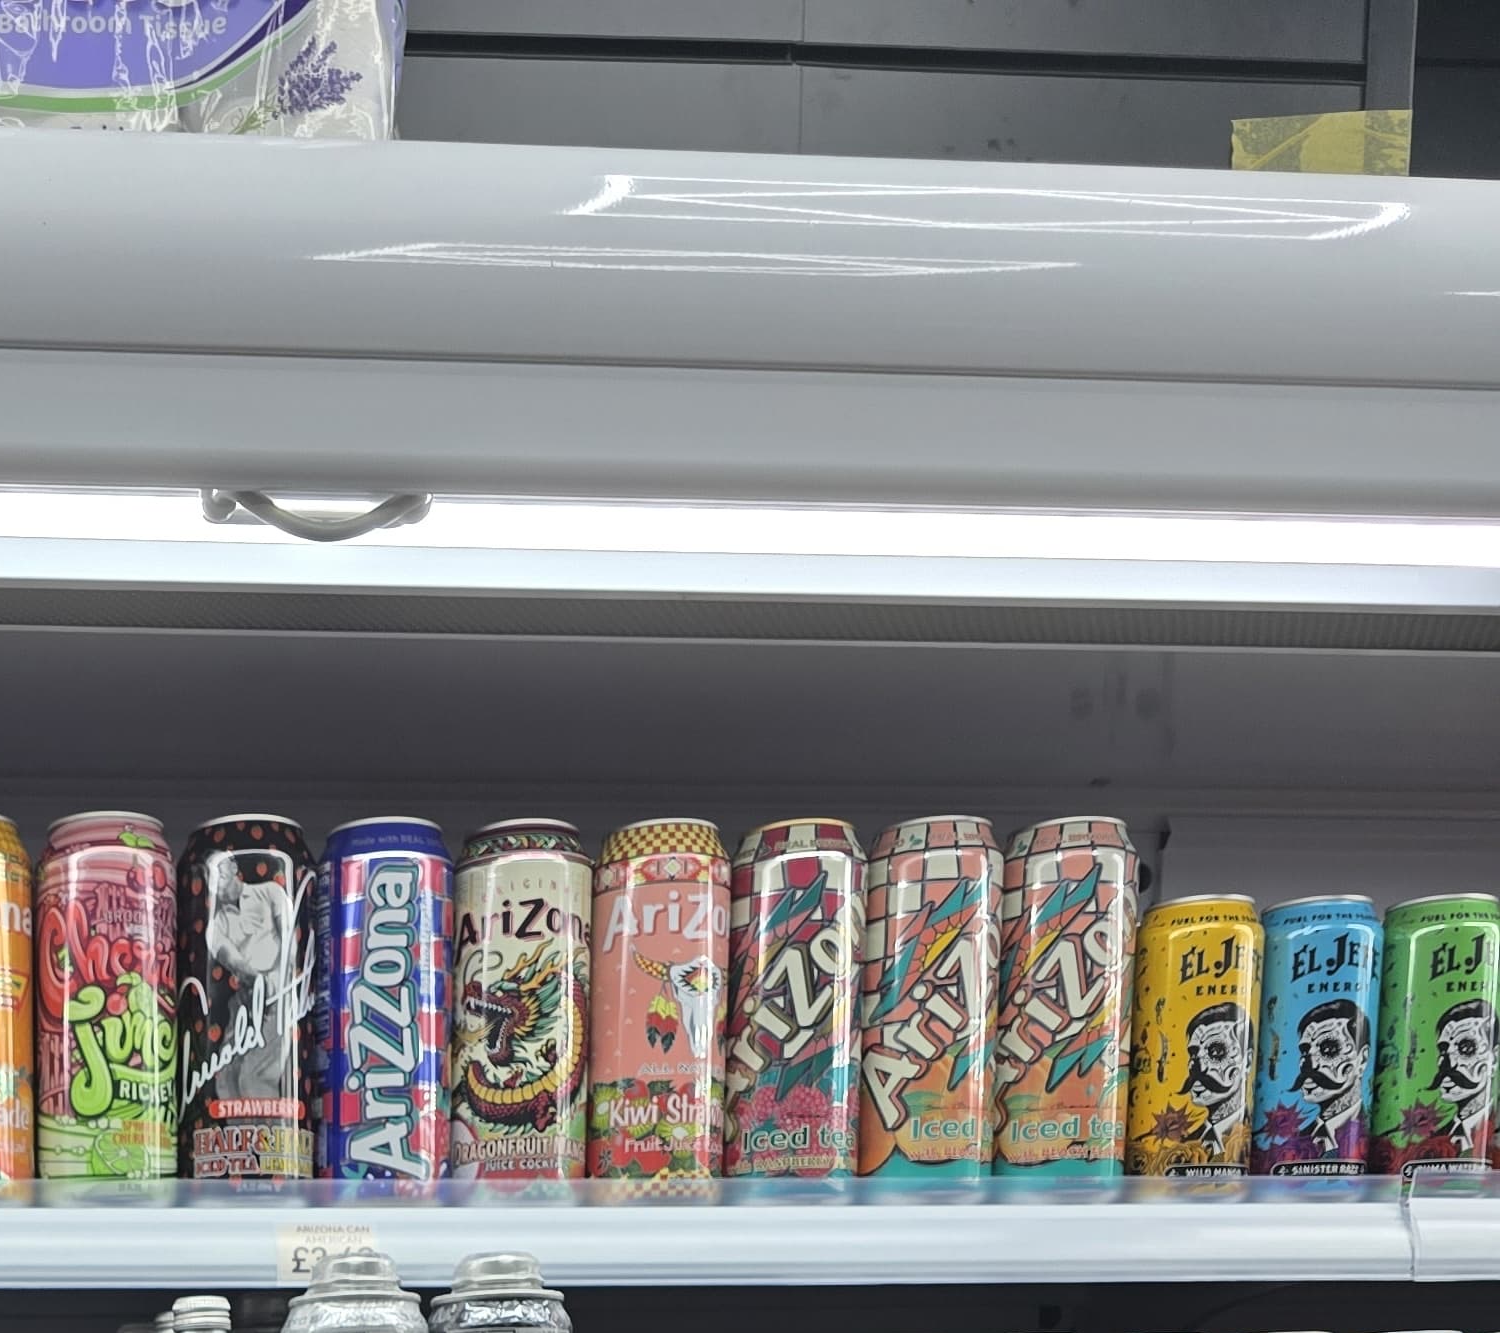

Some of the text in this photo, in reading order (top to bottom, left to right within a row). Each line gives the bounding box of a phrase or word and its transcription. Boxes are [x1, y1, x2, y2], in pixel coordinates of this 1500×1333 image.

[139, 13, 226, 36] Tissue
[349, 864, 430, 1181] AriZona
[219, 1102, 299, 1118] STRAWBERRY
[742, 1127, 855, 1153] Iced tea
[910, 1117, 977, 1142] Iced
[1011, 1118, 1123, 1144] Iced tea
